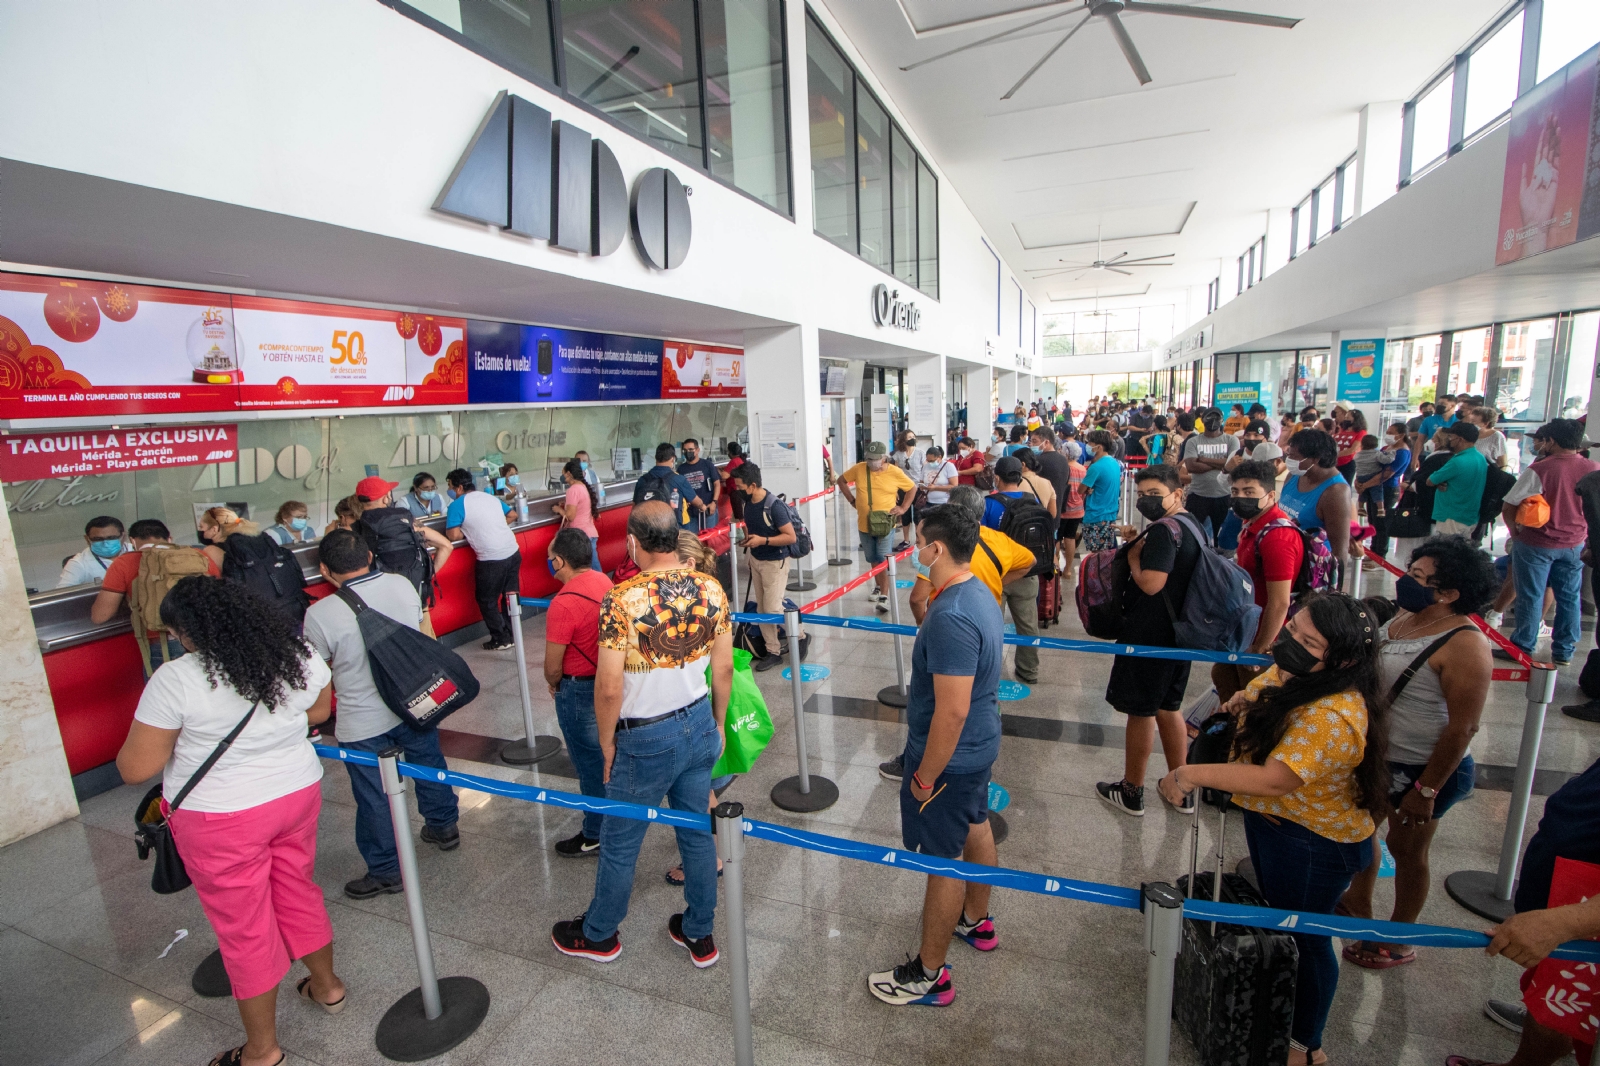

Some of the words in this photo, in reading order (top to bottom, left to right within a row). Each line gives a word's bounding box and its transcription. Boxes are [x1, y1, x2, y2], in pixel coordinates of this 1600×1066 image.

[431, 89, 692, 269] ADO
[202, 306, 224, 326] 365
[872, 283, 921, 331] Oriente
[258, 344, 324, 353] #COMPRACONTIEMPO
[263, 353, 267, 361] Y
[269, 352, 293, 362] OBTÉN
[295, 354, 316, 363] HASTA
[318, 355, 324, 363] EL
[330, 330, 367, 366] 50%
[559, 345, 567, 358] Para
[475, 351, 503, 371] ¡Estamos
[505, 354, 511, 371] de
[512, 355, 531, 372] vuelta!
[24, 394, 57, 402] TERMINA
[59, 394, 68, 402] EL
[69, 392, 84, 401] AÑO
[86, 393, 128, 401] CUMPLIENDO
[382, 386, 415, 401] ADO
[7, 434, 119, 455] TAQUILLA
[126, 428, 228, 447] EXCLUSIVA
[388, 433, 466, 467] ADO
[496, 428, 567, 454] Oriente
[1197, 443, 1228, 454] PUMA
[51, 462, 93, 475] Mérida
[107, 459, 138, 472] Playa
[140, 457, 157, 466] del
[160, 454, 198, 464] Carmen
[82, 450, 121, 462] Mérida
[135, 446, 173, 457] Cancún
[205, 450, 234, 460] ADO
[408, 691, 429, 708] SPORT
[428, 677, 445, 693] WEAR
[422, 691, 459, 720] COLLECTION
